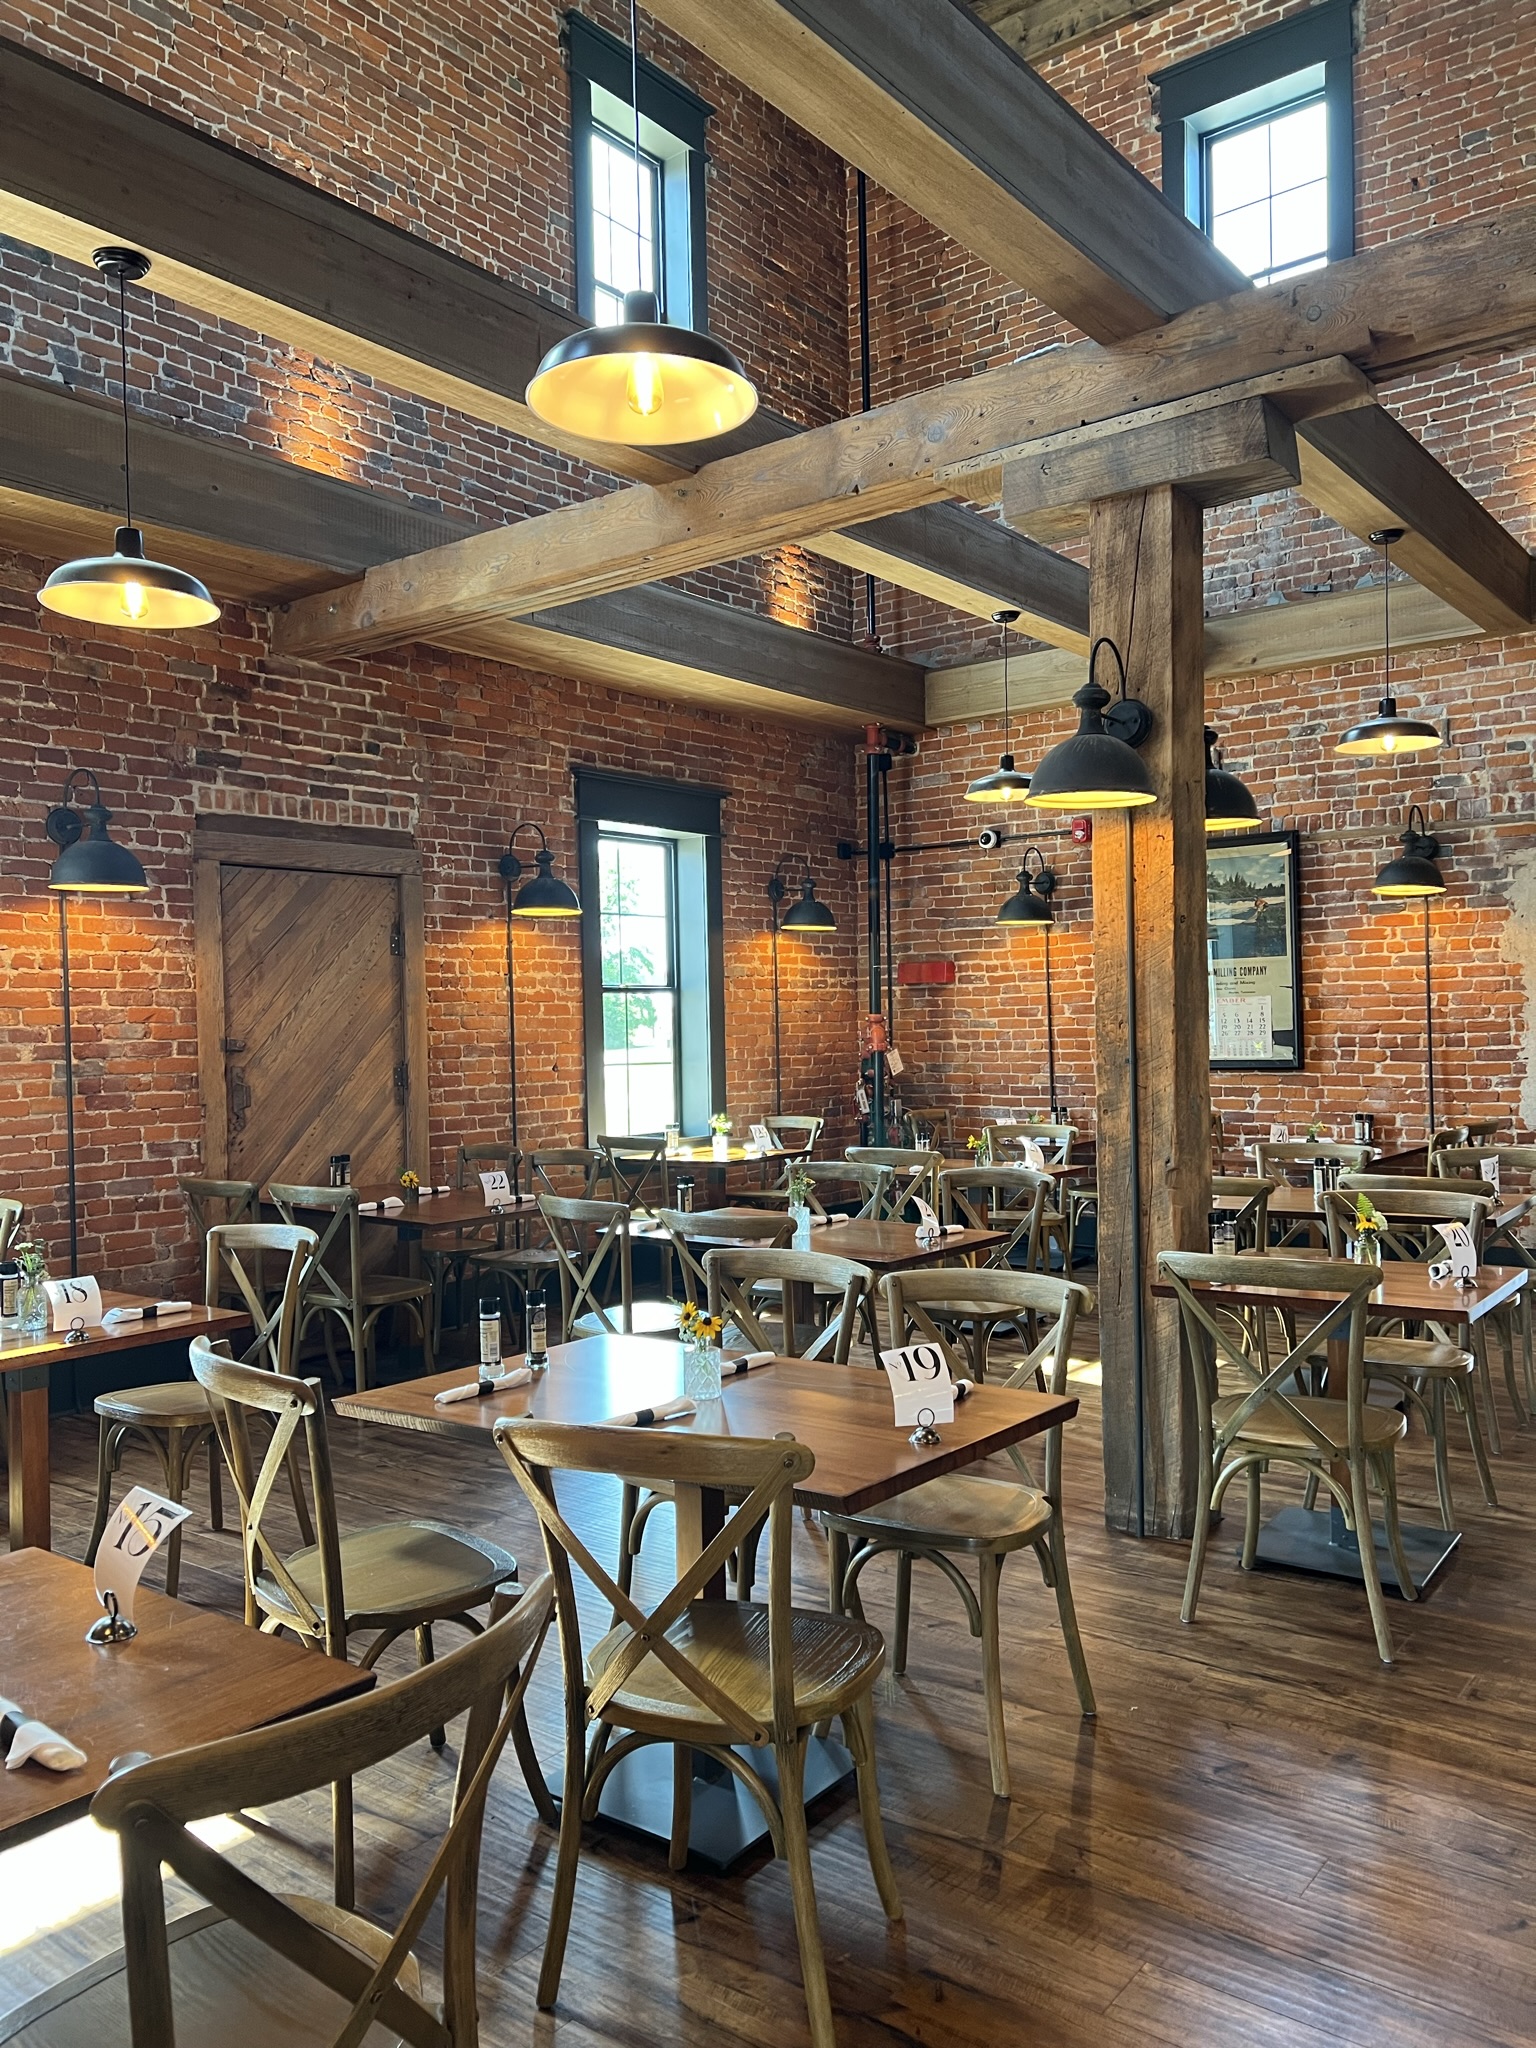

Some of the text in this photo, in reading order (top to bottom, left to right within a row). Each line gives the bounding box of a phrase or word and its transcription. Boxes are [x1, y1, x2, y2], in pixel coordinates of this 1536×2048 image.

[1213, 965, 1268, 978] MILLING COMPANY
[488, 1174, 506, 1190] 22
[60, 1280, 88, 1304] 18
[899, 1345, 942, 1383] 19
[113, 1501, 180, 1557] 15
